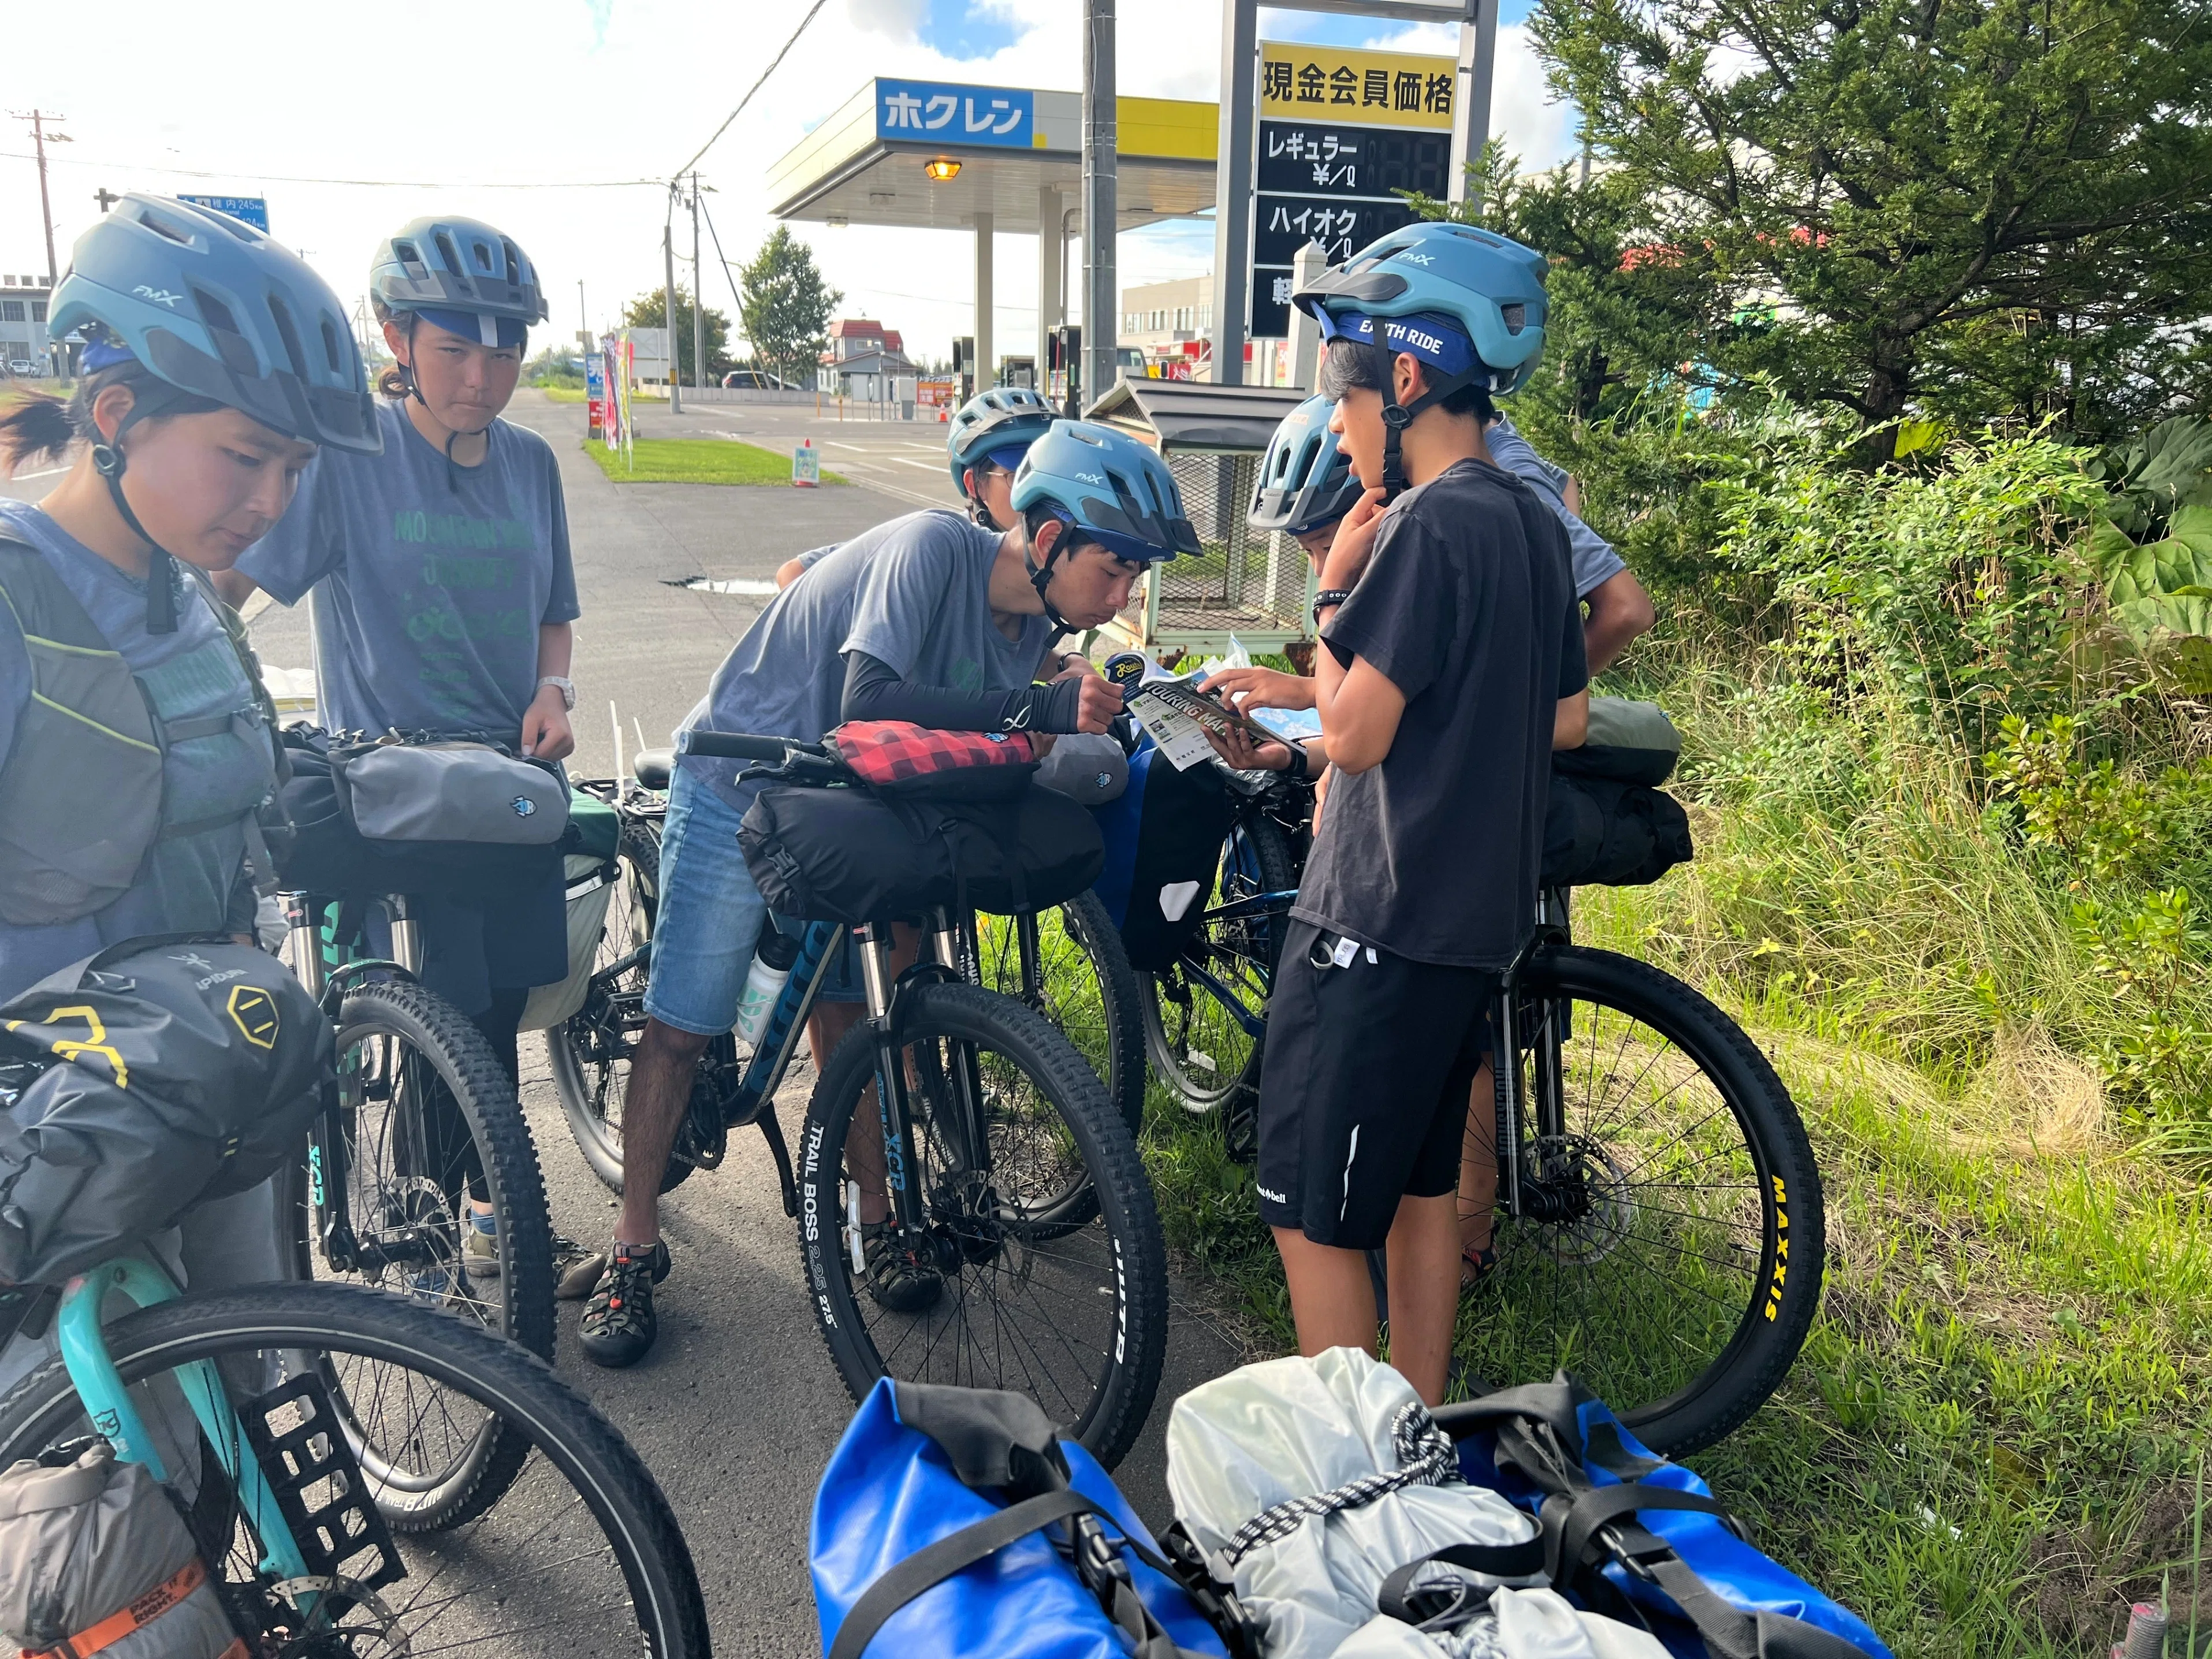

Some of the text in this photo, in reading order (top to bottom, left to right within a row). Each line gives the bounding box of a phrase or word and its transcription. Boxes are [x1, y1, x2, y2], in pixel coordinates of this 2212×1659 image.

[1263, 61, 1453, 114] 現金会員価格
[885, 92, 1022, 134] ホクレン
[1268, 131, 1357, 161] レギュラー
[1269, 207, 1357, 236] ハイオク
[1406, 328, 1444, 355] RIDE
[1145, 684, 1204, 717] TOURING
[805, 1125, 824, 1178] TRAIL
[804, 1182, 819, 1242] BOSS
[1765, 1174, 1788, 1322] MAXXIS
[809, 1245, 826, 1291] 2.25
[385, 1494, 405, 1508] TRAIL
[129, 1587, 167, 1615] PACK
